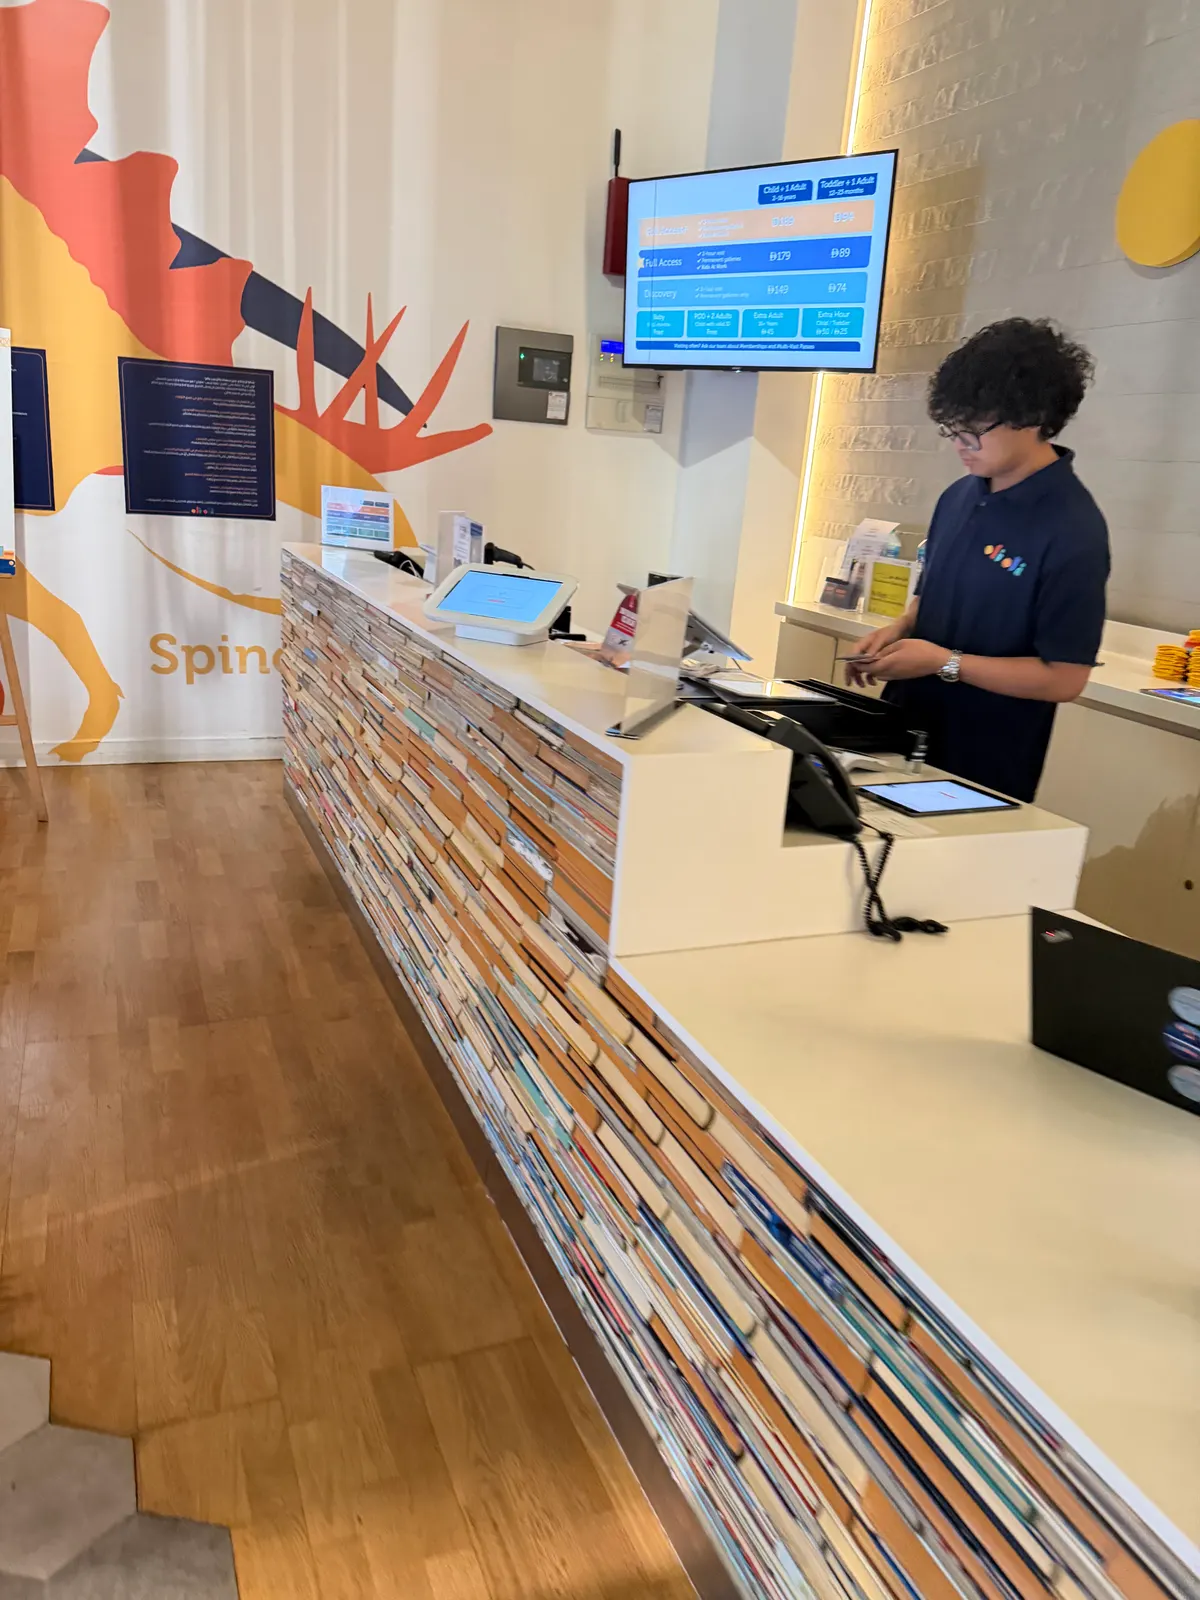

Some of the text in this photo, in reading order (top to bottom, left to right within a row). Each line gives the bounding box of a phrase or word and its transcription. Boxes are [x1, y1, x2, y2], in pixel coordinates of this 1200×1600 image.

[763, 185, 780, 194] Child
[790, 182, 807, 192] Adult
[820, 179, 844, 189] Toddler
[856, 176, 875, 185] Adult
[645, 258, 682, 268] Full Access
[644, 290, 677, 300] Discovery
